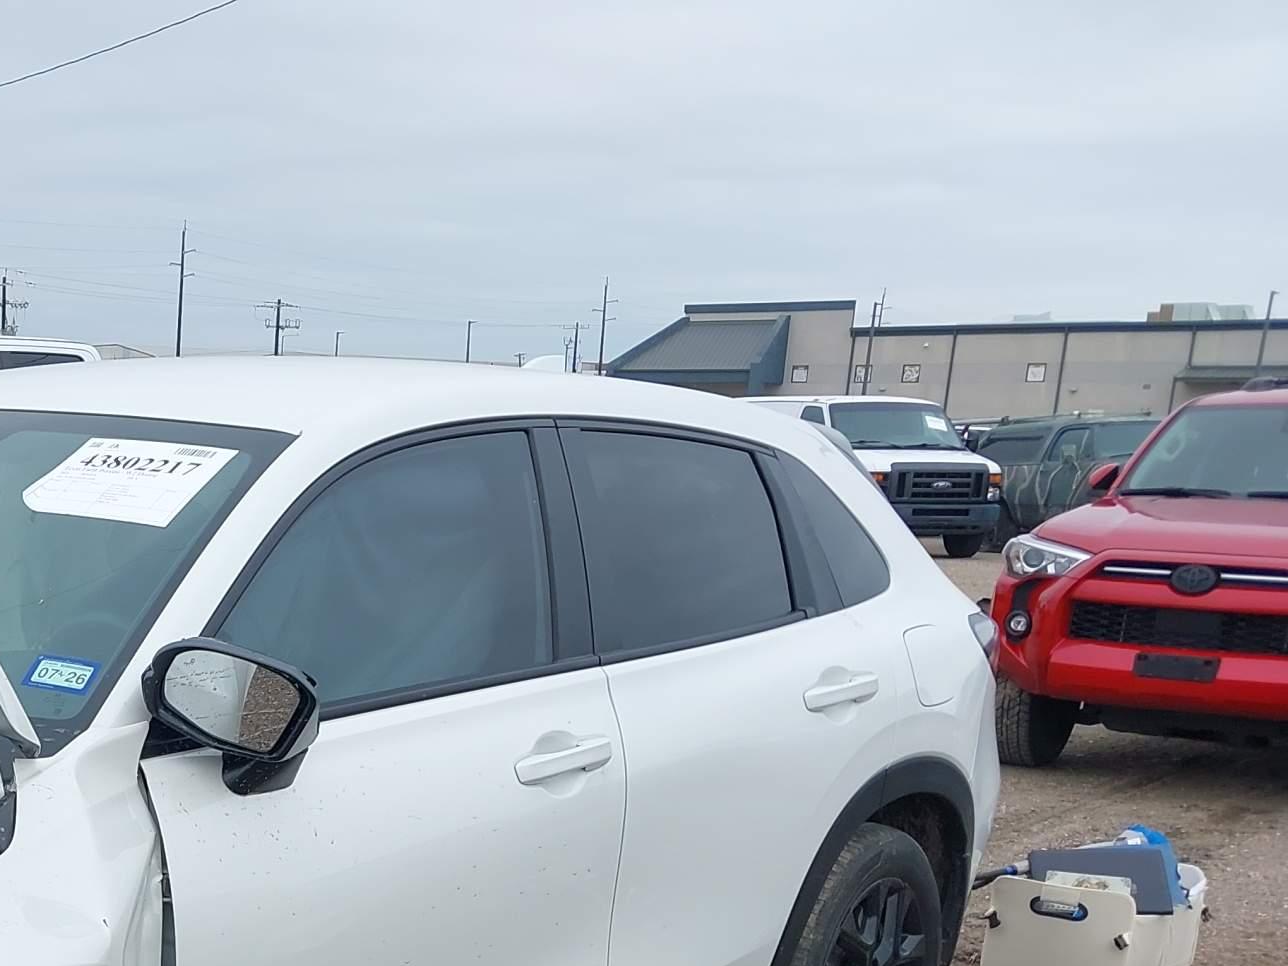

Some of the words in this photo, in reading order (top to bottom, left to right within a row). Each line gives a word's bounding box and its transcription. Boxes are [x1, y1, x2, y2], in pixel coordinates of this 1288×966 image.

[80, 453, 203, 476] 43802217
[37, 667, 60, 679] 07
[64, 671, 88, 685] 26
